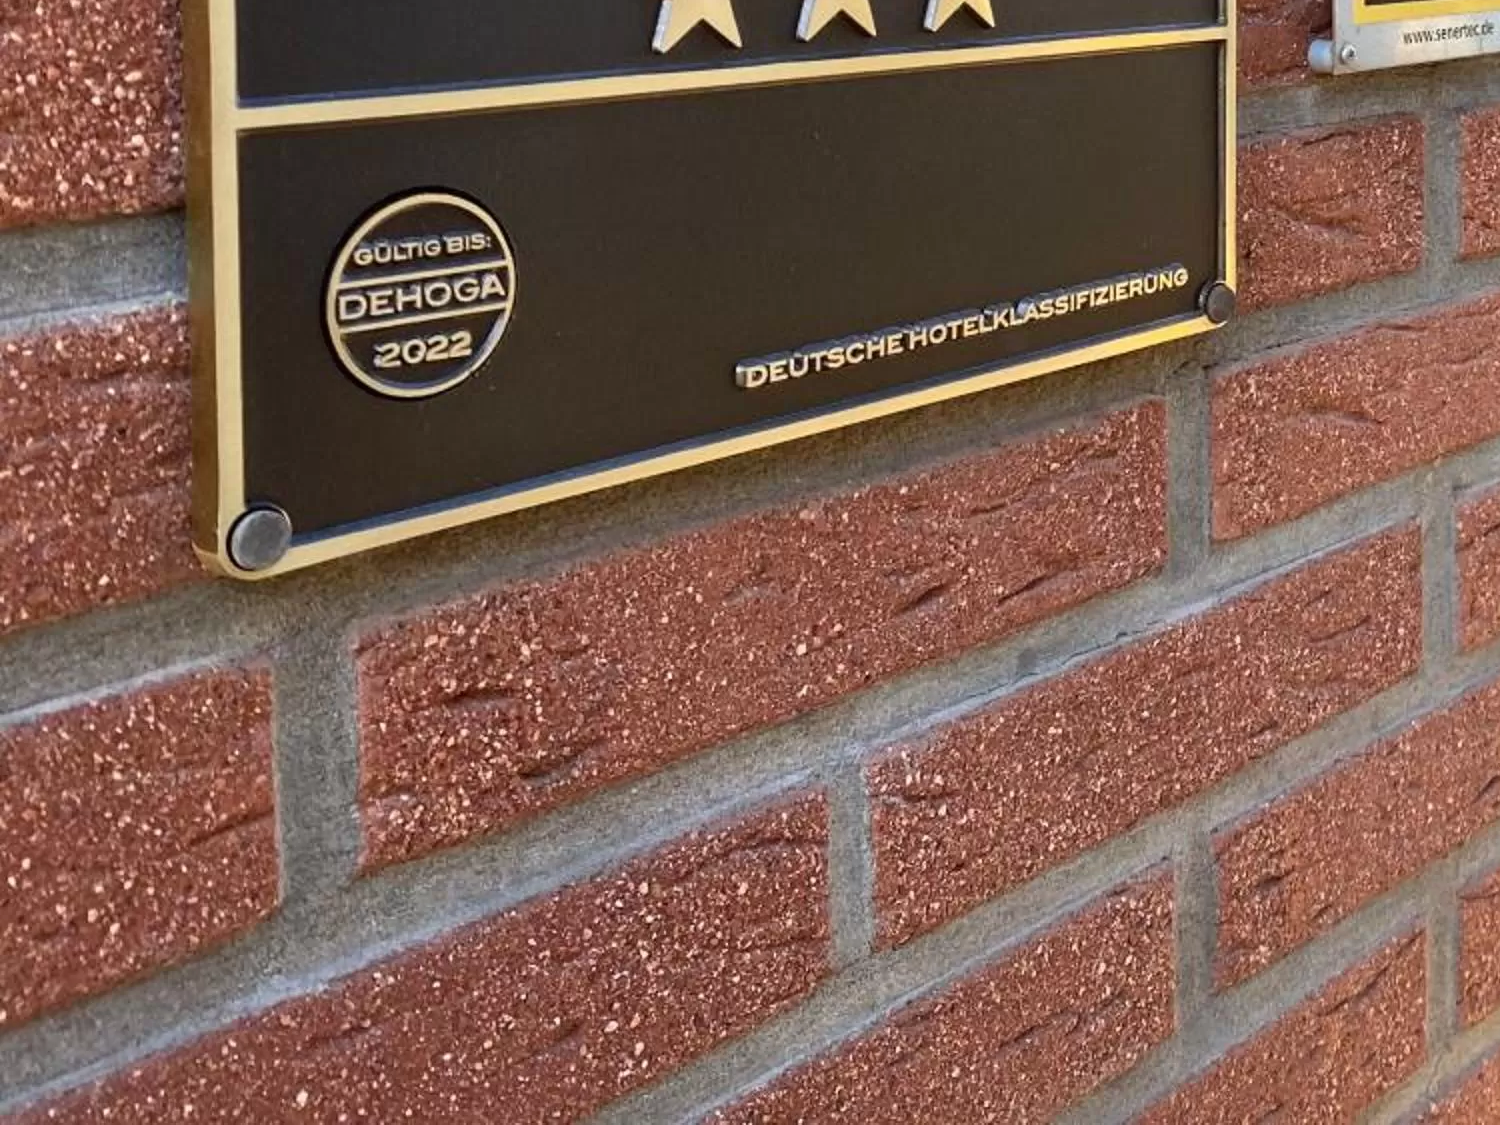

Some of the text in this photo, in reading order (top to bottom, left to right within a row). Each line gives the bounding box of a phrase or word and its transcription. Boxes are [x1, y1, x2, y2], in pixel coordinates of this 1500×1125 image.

[337, 273, 506, 321] DEHOGA
[373, 330, 473, 368] 2022
[736, 266, 1189, 389] DEUTSCHE HOTELKLASSIFIZIERUNG
